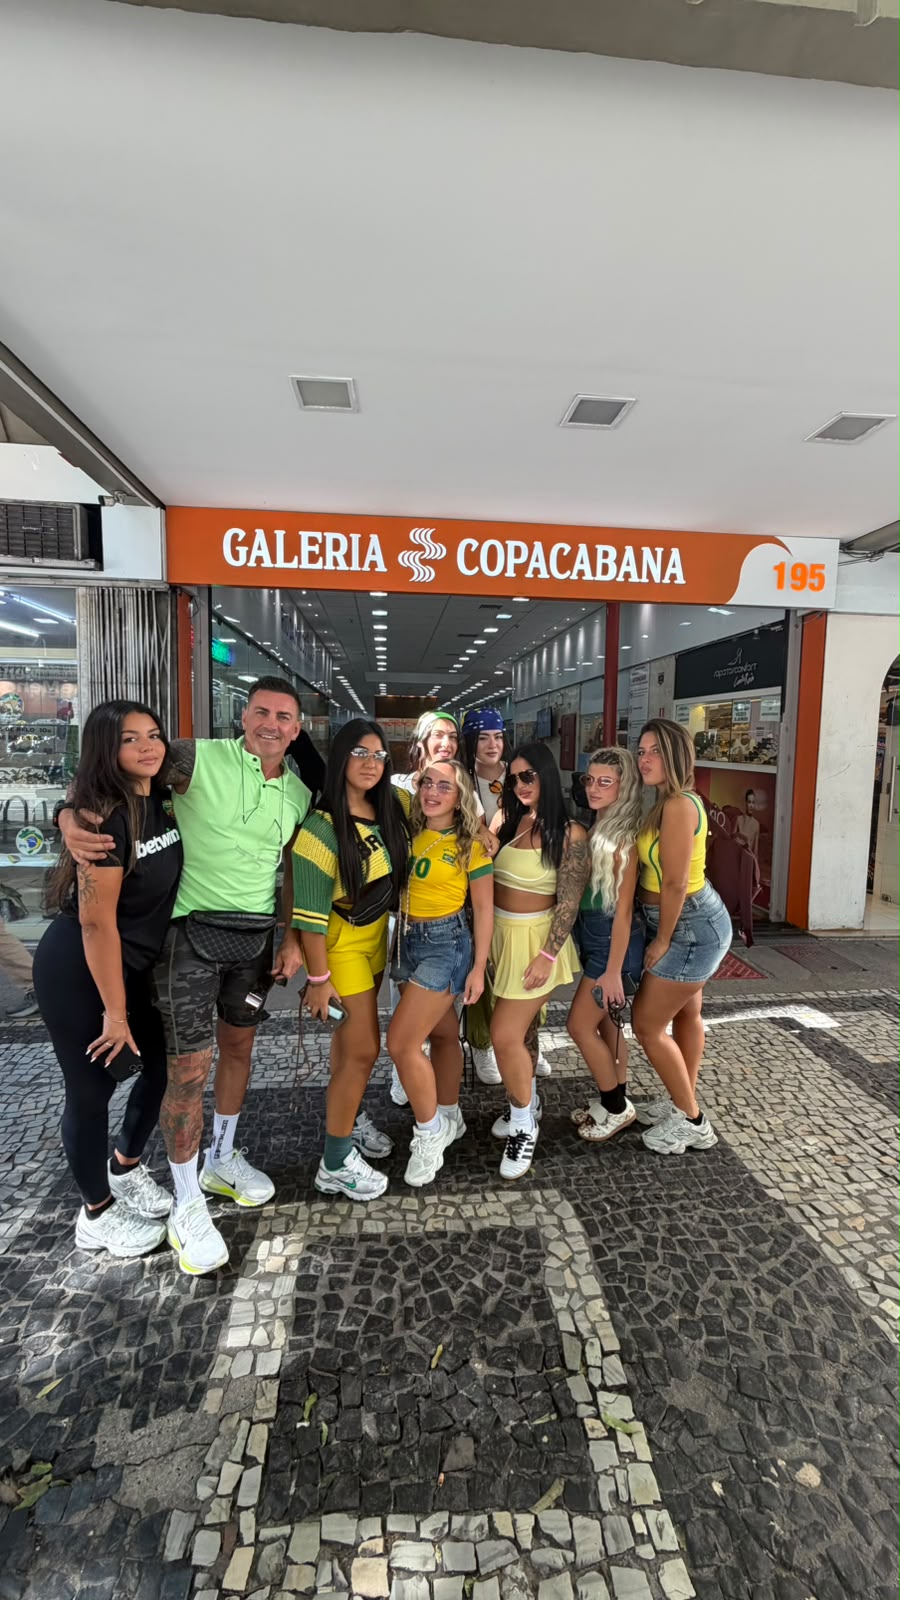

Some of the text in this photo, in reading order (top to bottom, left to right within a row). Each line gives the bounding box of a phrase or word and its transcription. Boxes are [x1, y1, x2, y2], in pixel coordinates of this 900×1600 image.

[223, 528, 687, 585] GALERIA COPACABANA
[774, 562, 825, 592] 195
[135, 827, 180, 859] betwin
